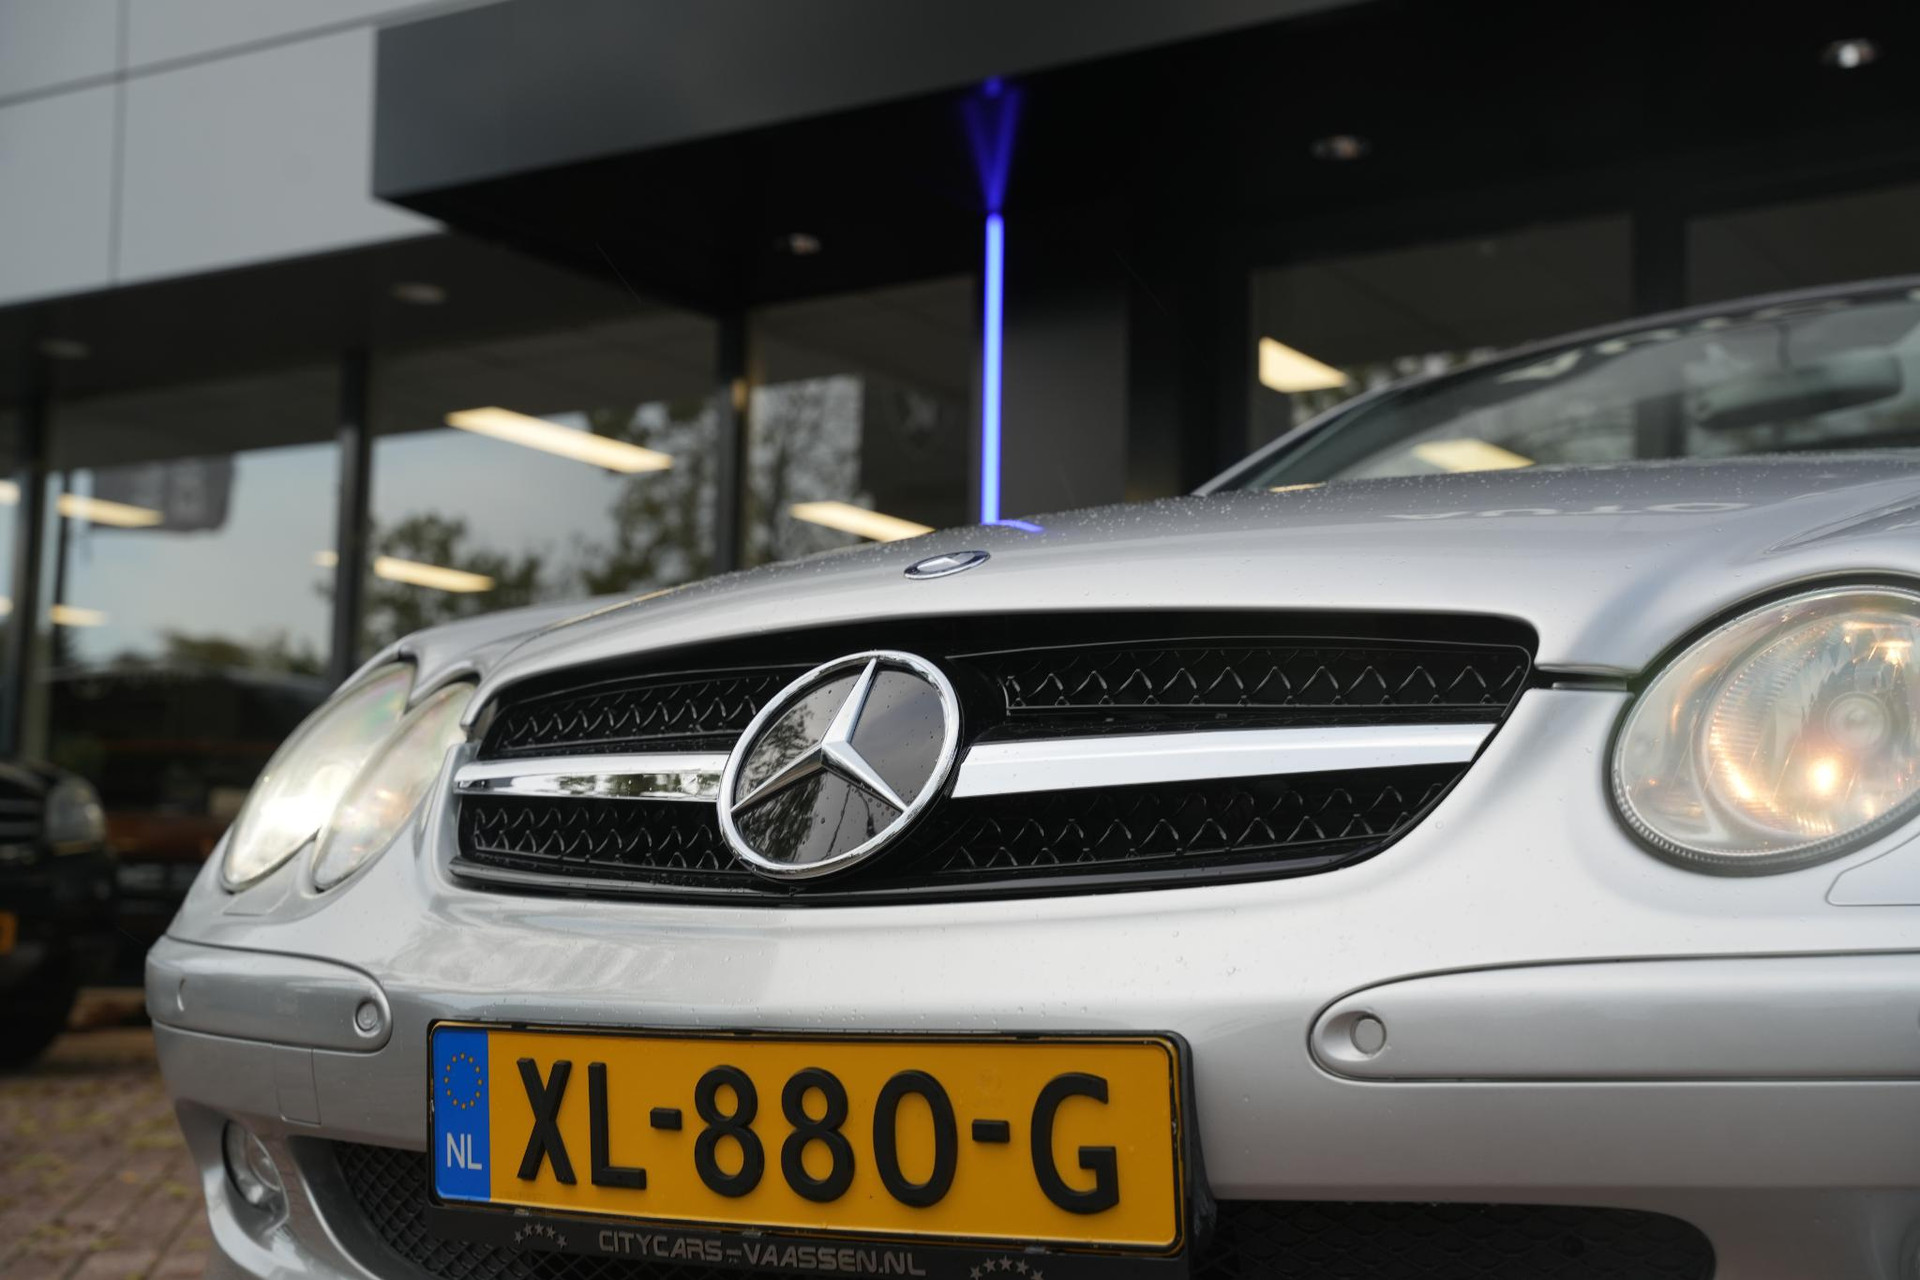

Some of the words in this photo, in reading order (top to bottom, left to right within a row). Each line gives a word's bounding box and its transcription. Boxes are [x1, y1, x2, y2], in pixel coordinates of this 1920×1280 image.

[446, 1132, 482, 1170] NL
[516, 1057, 1120, 1215] XL-880-G
[599, 1230, 926, 1276] CITYCARS-VAASSEN.NL
